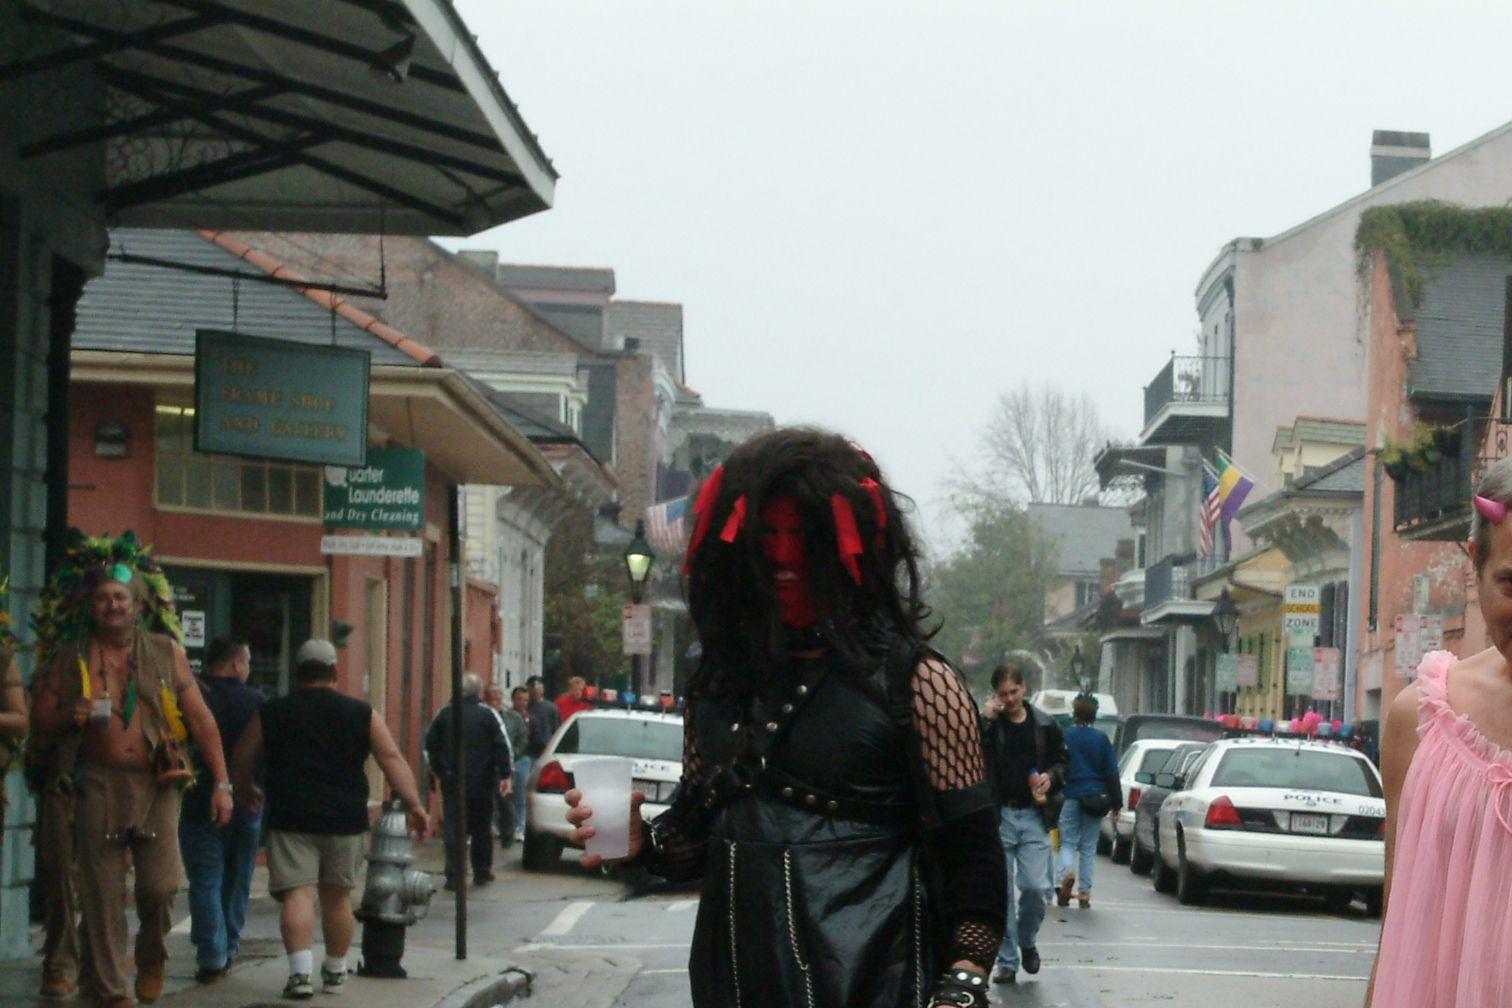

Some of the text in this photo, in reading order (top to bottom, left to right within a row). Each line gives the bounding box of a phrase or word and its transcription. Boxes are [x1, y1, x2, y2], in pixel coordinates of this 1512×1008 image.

[267, 417, 348, 442] GALLERY
[348, 486, 419, 505] Launderette
[325, 507, 419, 526] and Dry Cleaning
[1291, 588, 1315, 599] END
[1286, 604, 1320, 613] SCHOOL
[1286, 618, 1317, 628] ZONE
[1284, 793, 1342, 805] POLICE
